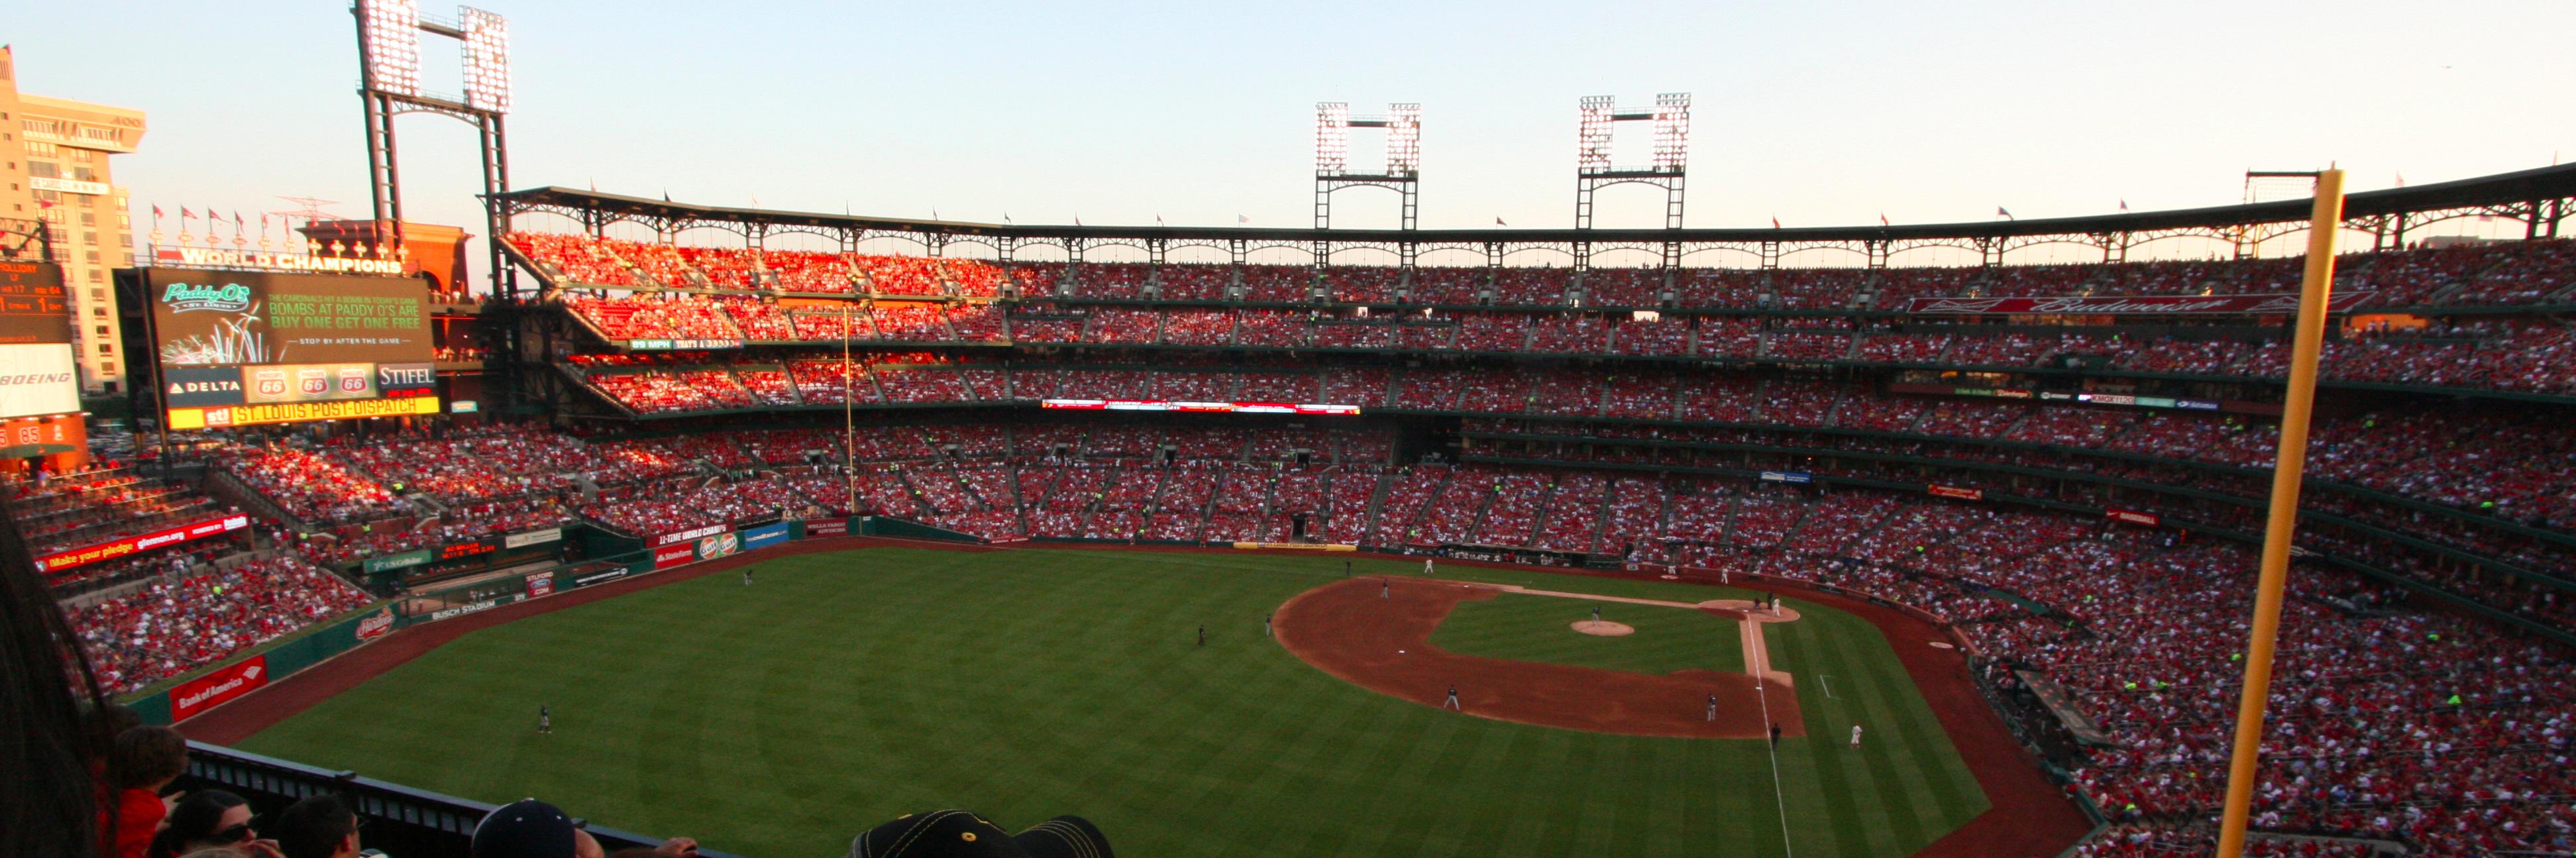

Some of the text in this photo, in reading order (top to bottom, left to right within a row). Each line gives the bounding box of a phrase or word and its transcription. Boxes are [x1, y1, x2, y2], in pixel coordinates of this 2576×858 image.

[180, 247, 402, 274] WORLD CHAMPIONS
[162, 282, 220, 303] Paddy
[269, 302, 419, 317] BOMBS AT PADDY O'S ARE
[2029, 297, 2231, 313] Budweiser
[270, 315, 420, 329] BUY ONE GET ONE FREE
[0, 373, 71, 386] BOEING
[344, 378, 364, 390] 66
[380, 367, 435, 386] STIFEL
[186, 380, 241, 393] DELTA
[261, 380, 283, 393] 66
[303, 379, 325, 392] 66
[237, 398, 417, 422] ST. LOUIS POST-DISPATCH
[19, 426, 40, 445] 85
[659, 524, 727, 545] 11-TIME WORLD CHAMPS
[49, 553, 78, 568] Make
[79, 551, 101, 564] your
[102, 543, 133, 559] pledge
[136, 531, 186, 550] glennon.org
[700, 541, 718, 555] Gulf
[720, 537, 737, 551] Gulf
[431, 600, 496, 620] BUSCH STADIUM
[178, 677, 244, 709] Bank of America
